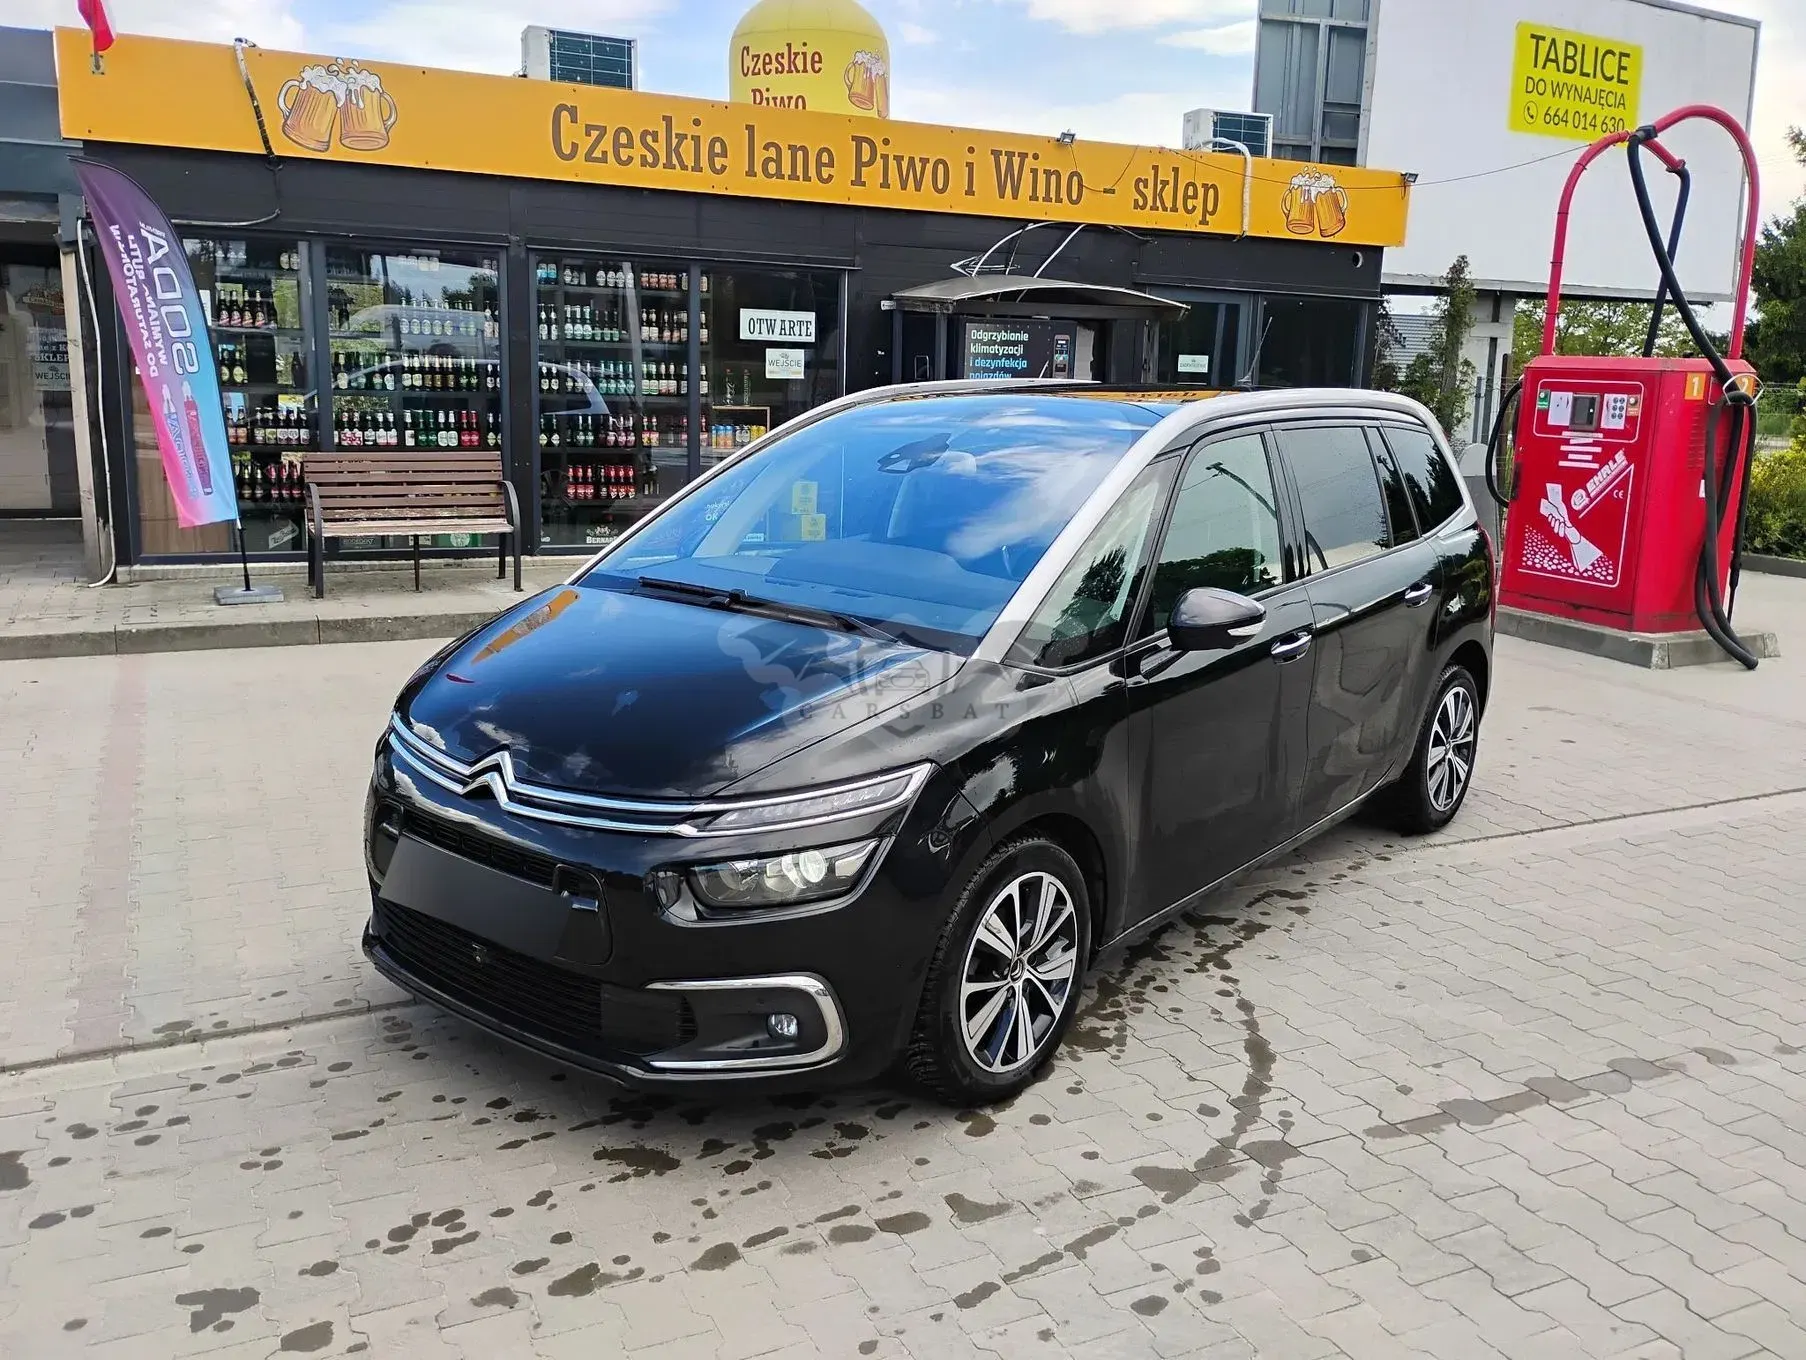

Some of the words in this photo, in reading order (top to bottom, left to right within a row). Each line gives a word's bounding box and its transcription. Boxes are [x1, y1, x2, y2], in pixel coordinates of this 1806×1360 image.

[741, 42, 823, 77] Czeskie
[1530, 33, 1631, 85] TABLICE
[1525, 76, 1547, 96] DO
[1551, 79, 1627, 110] WYNAJĘCIA
[1543, 106, 1569, 127] 664
[1572, 110, 1598, 132] 014
[1600, 115, 1626, 134] 630
[551, 102, 728, 176] Czeskie
[745, 123, 835, 185] lane
[850, 135, 950, 195] Piwo
[964, 146, 976, 196] i
[991, 149, 1084, 205] Wino
[1133, 164, 1220, 226] sklep
[748, 317, 812, 337] OTWARTE
[971, 329, 1029, 342] Odgrzybianie
[970, 343, 1024, 356] klimatyzacji
[975, 357, 1027, 370] dezynfekcja
[1692, 376, 1700, 397] 1
[1586, 449, 1627, 495] EHRLE
